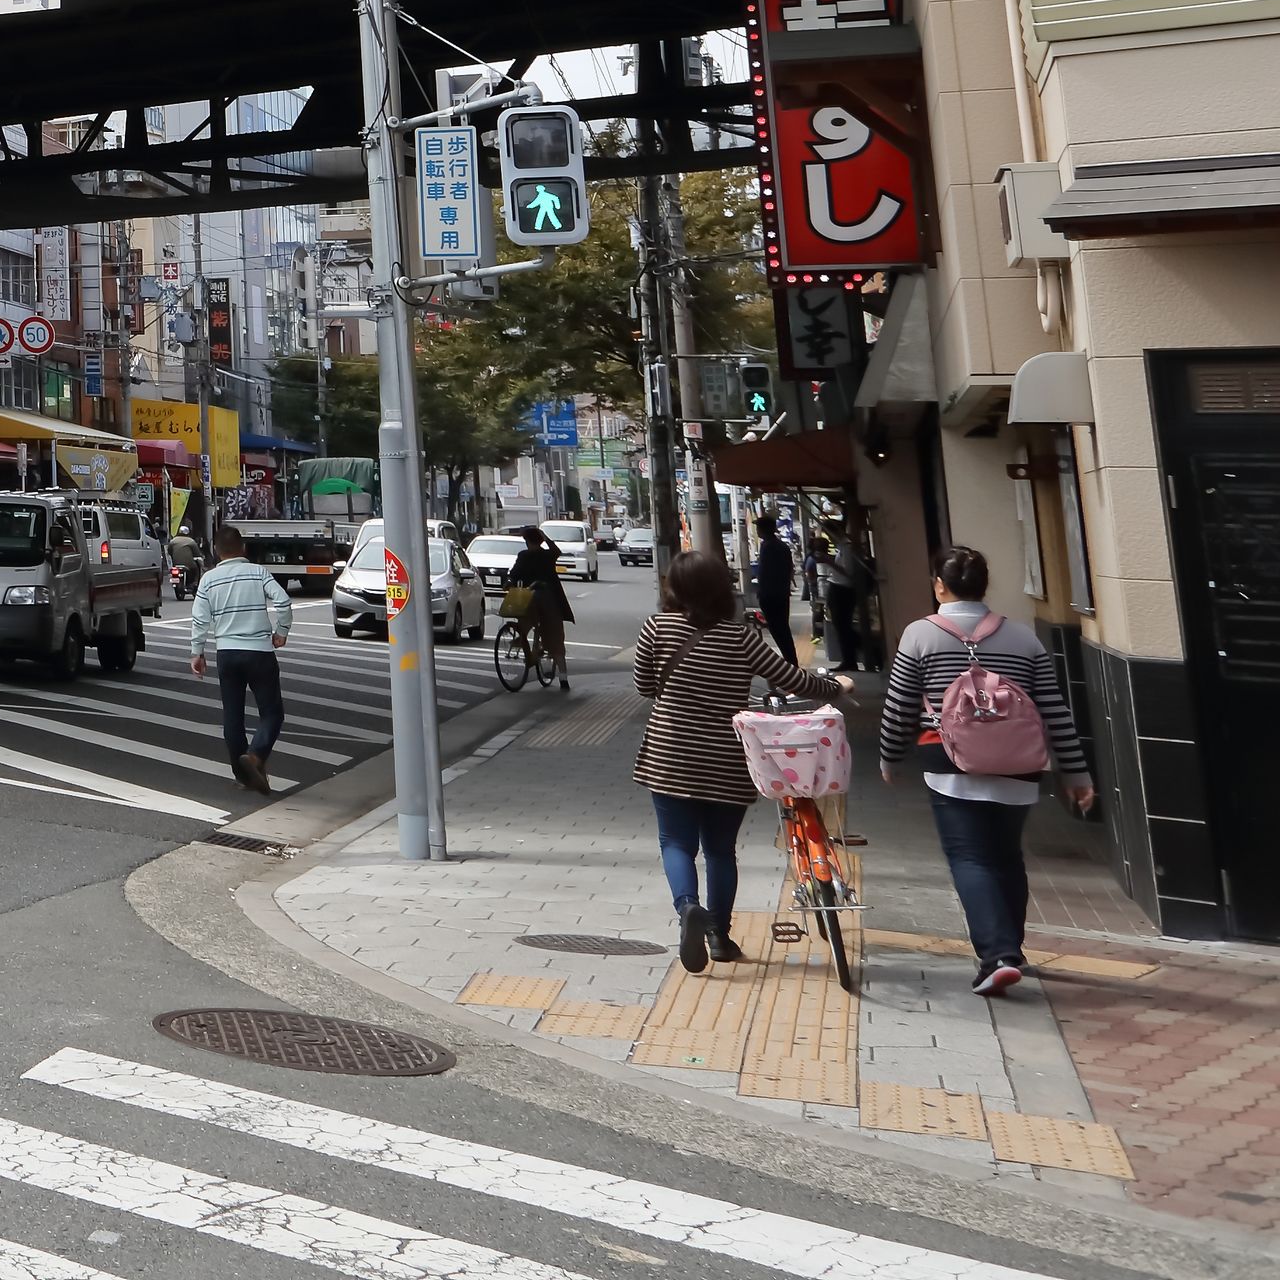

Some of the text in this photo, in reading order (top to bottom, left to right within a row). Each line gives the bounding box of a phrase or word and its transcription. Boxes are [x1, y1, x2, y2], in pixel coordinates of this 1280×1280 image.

[439, 206, 459, 250] 専用
[25, 327, 47, 343] 50
[386, 558, 399, 583] 栓
